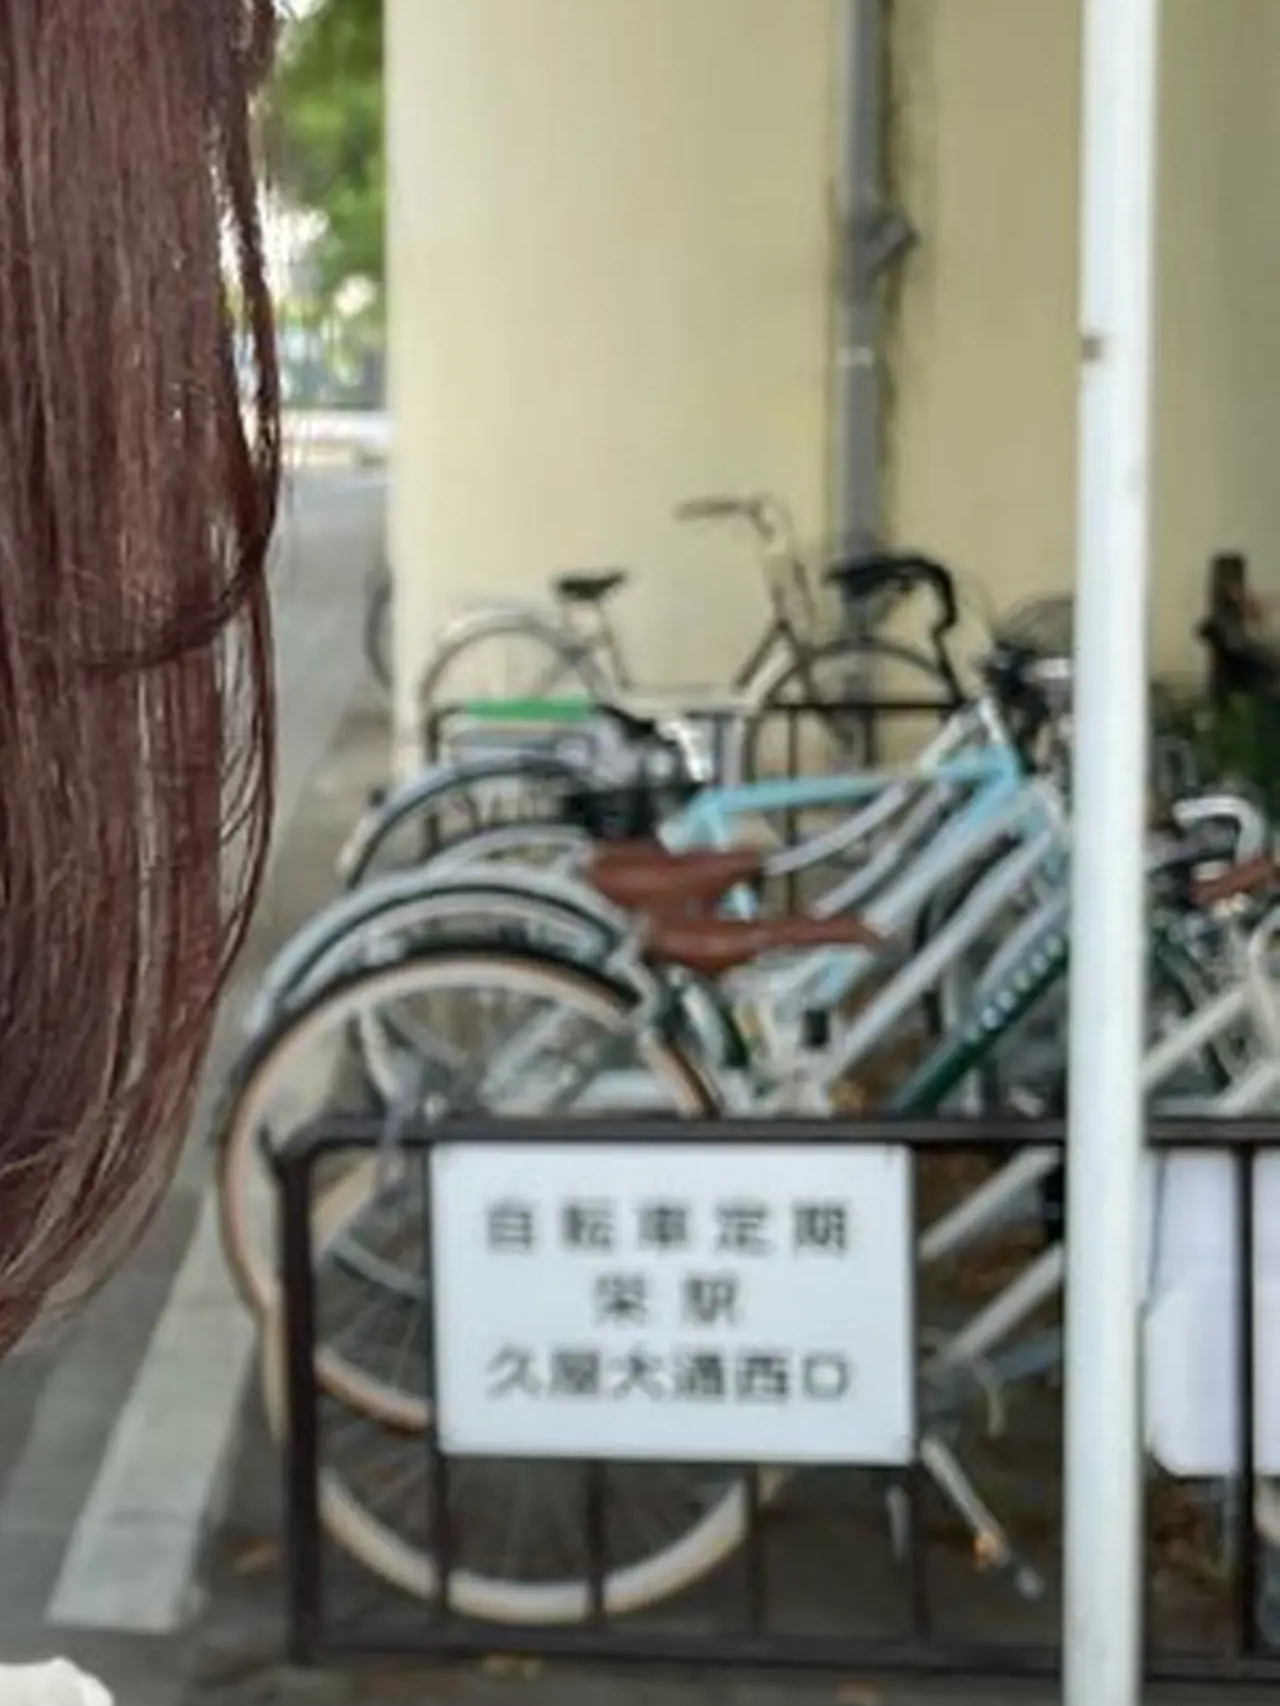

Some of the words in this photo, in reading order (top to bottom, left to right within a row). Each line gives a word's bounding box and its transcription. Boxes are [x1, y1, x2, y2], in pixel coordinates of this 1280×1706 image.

[486, 1200, 849, 1256] 自転車定期
